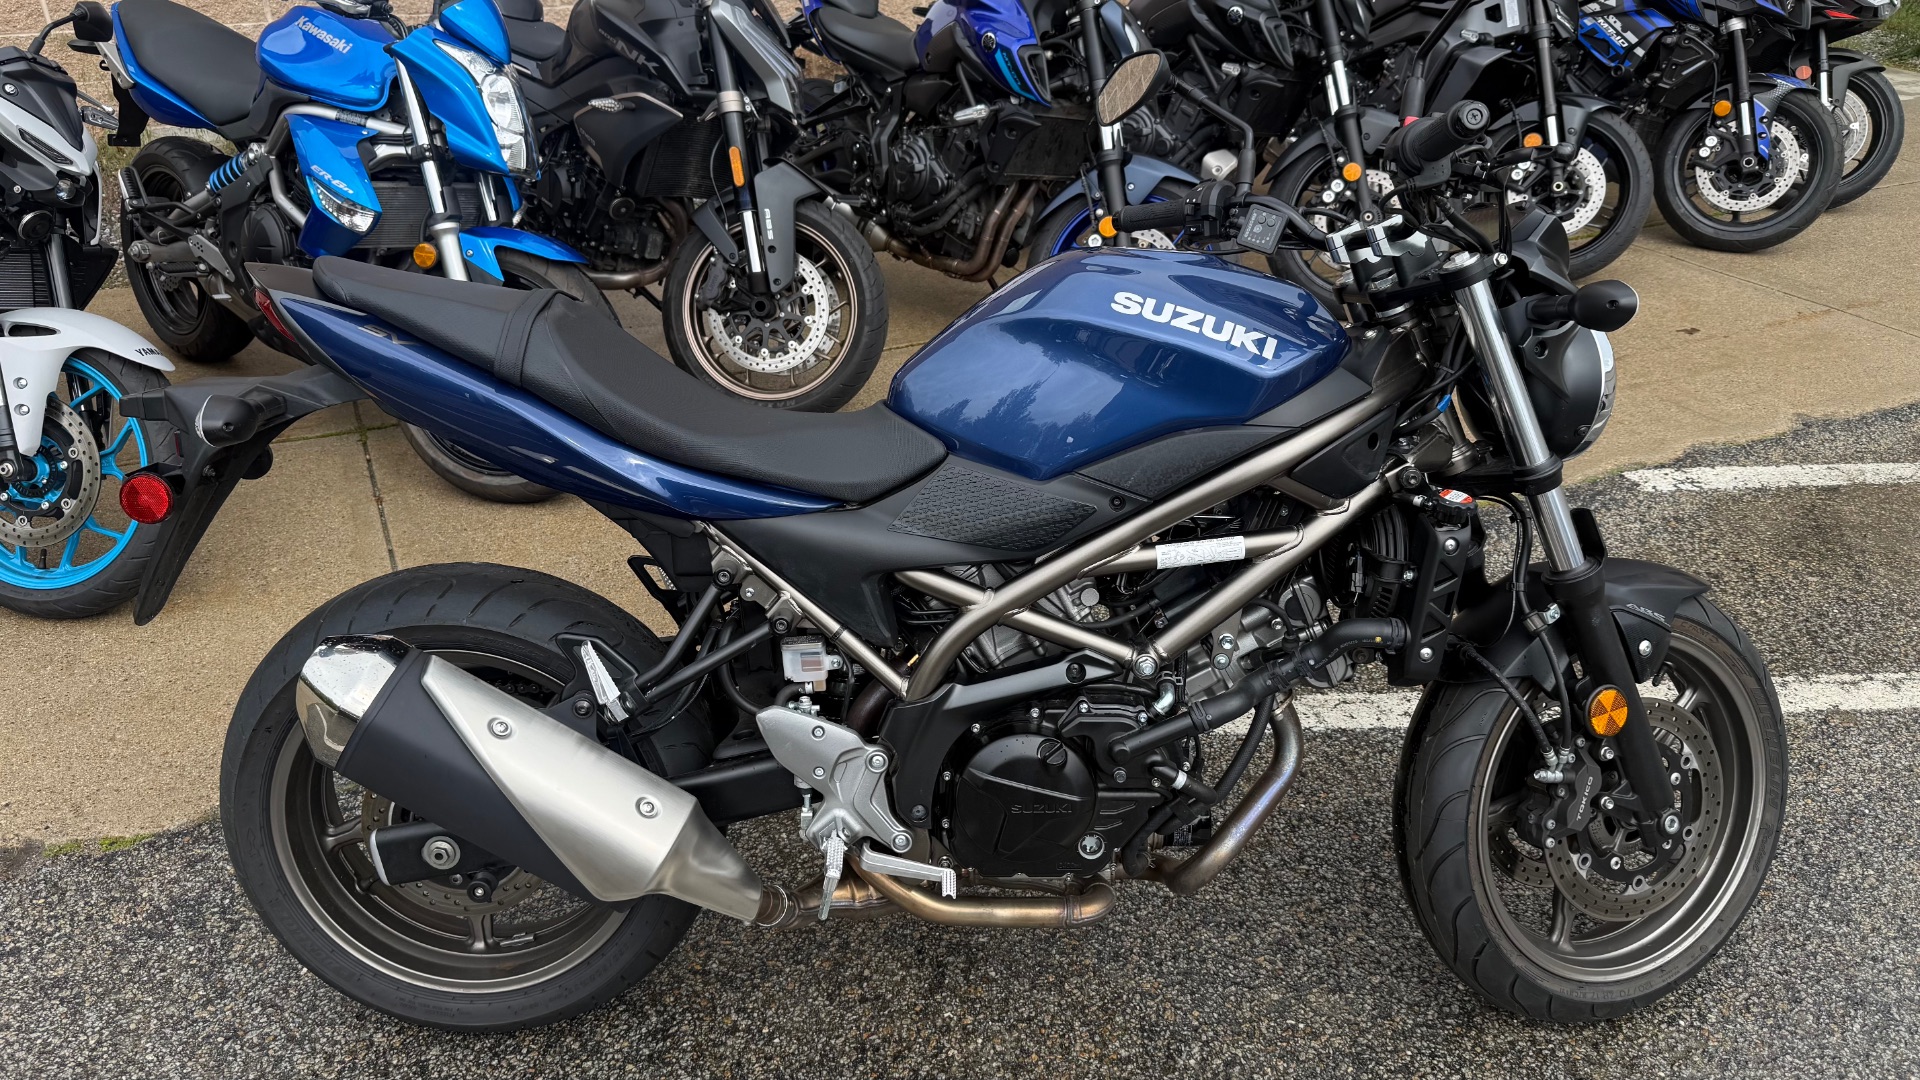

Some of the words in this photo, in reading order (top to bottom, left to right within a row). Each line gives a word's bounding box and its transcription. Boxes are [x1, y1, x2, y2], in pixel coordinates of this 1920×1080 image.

[294, 15, 353, 54] Kawasaki
[764, 208, 774, 240] ABS
[1110, 291, 1278, 361] SUZUKI
[1011, 803, 1073, 814] SUZUKI
[1576, 776, 1593, 821] TOKICO
